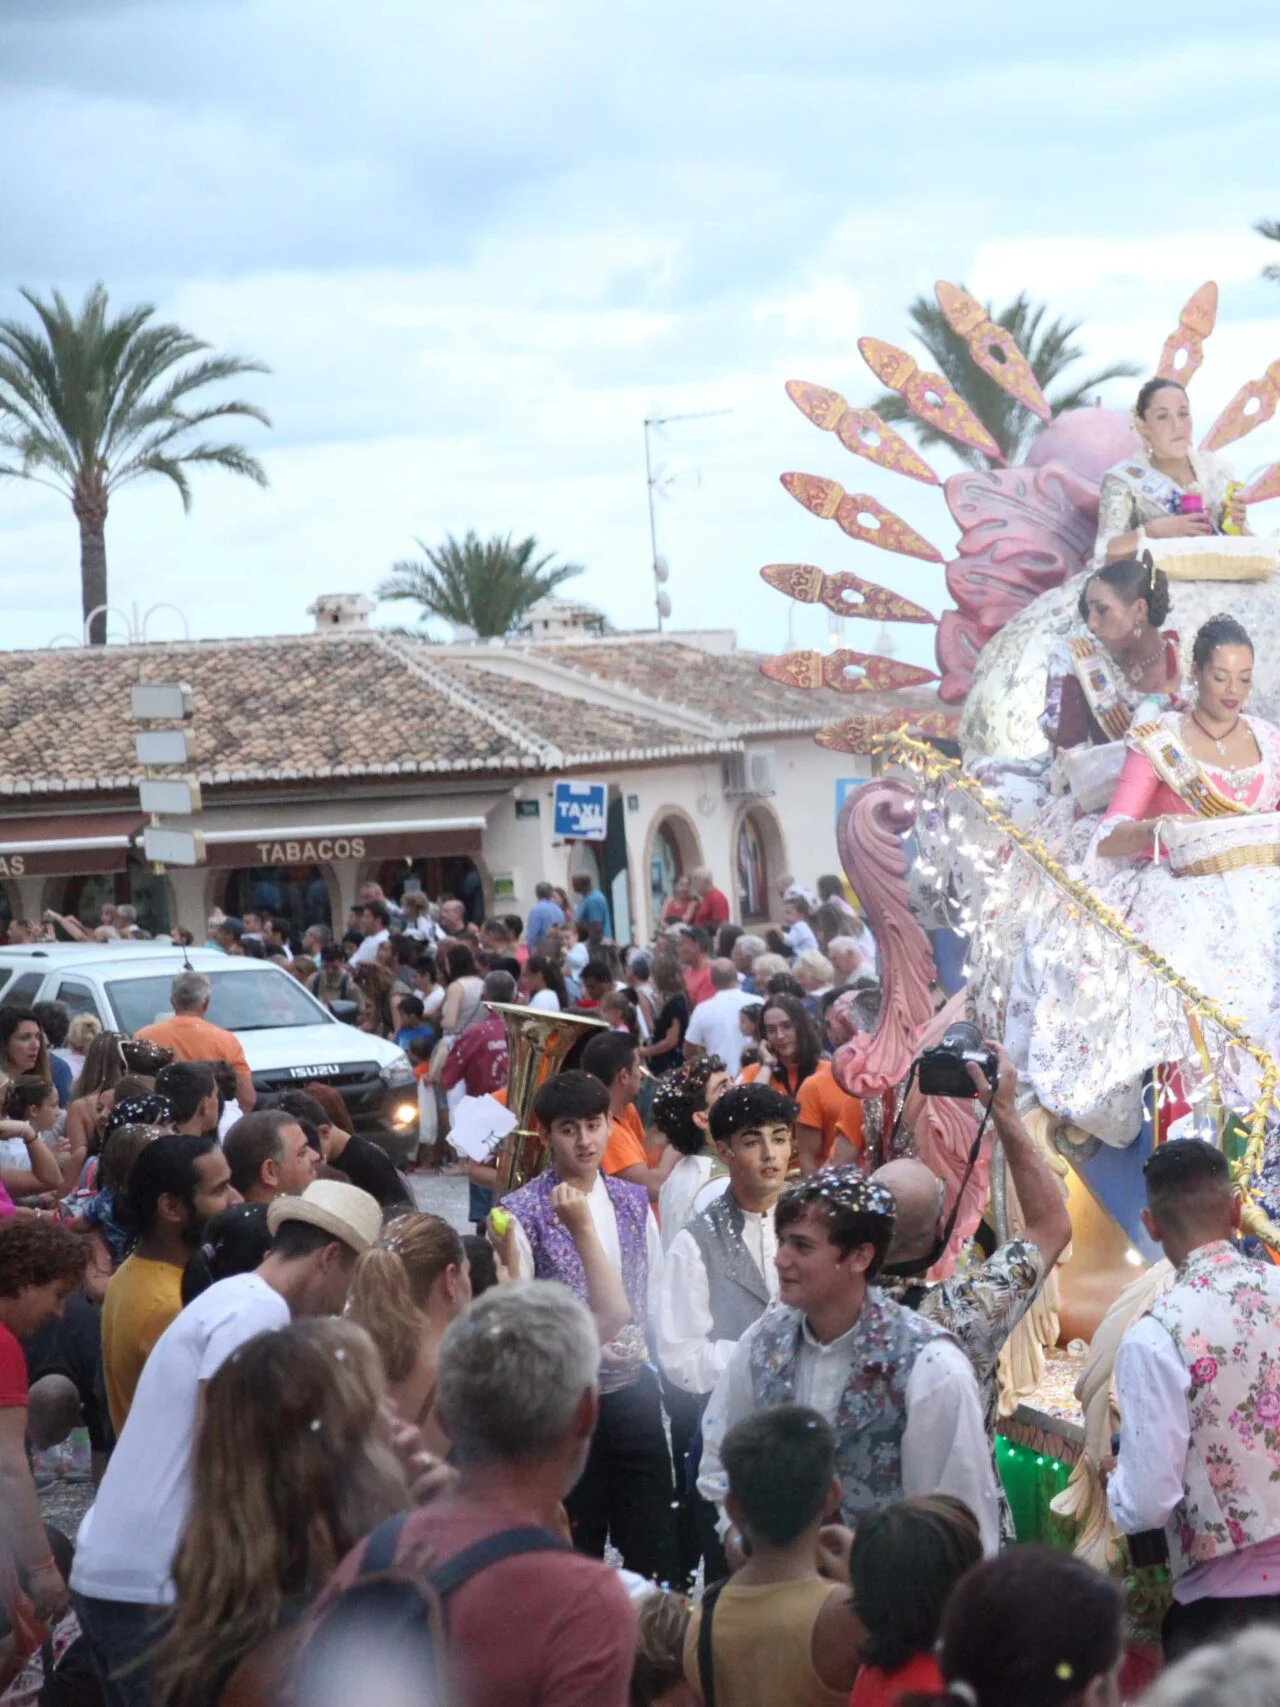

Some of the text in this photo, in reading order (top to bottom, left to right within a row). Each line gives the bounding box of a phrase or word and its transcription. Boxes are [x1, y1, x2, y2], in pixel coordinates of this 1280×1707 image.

[558, 801, 601, 818] TAXI
[256, 838, 366, 863] TABACOS
[289, 1064, 340, 1078] ISUZU
